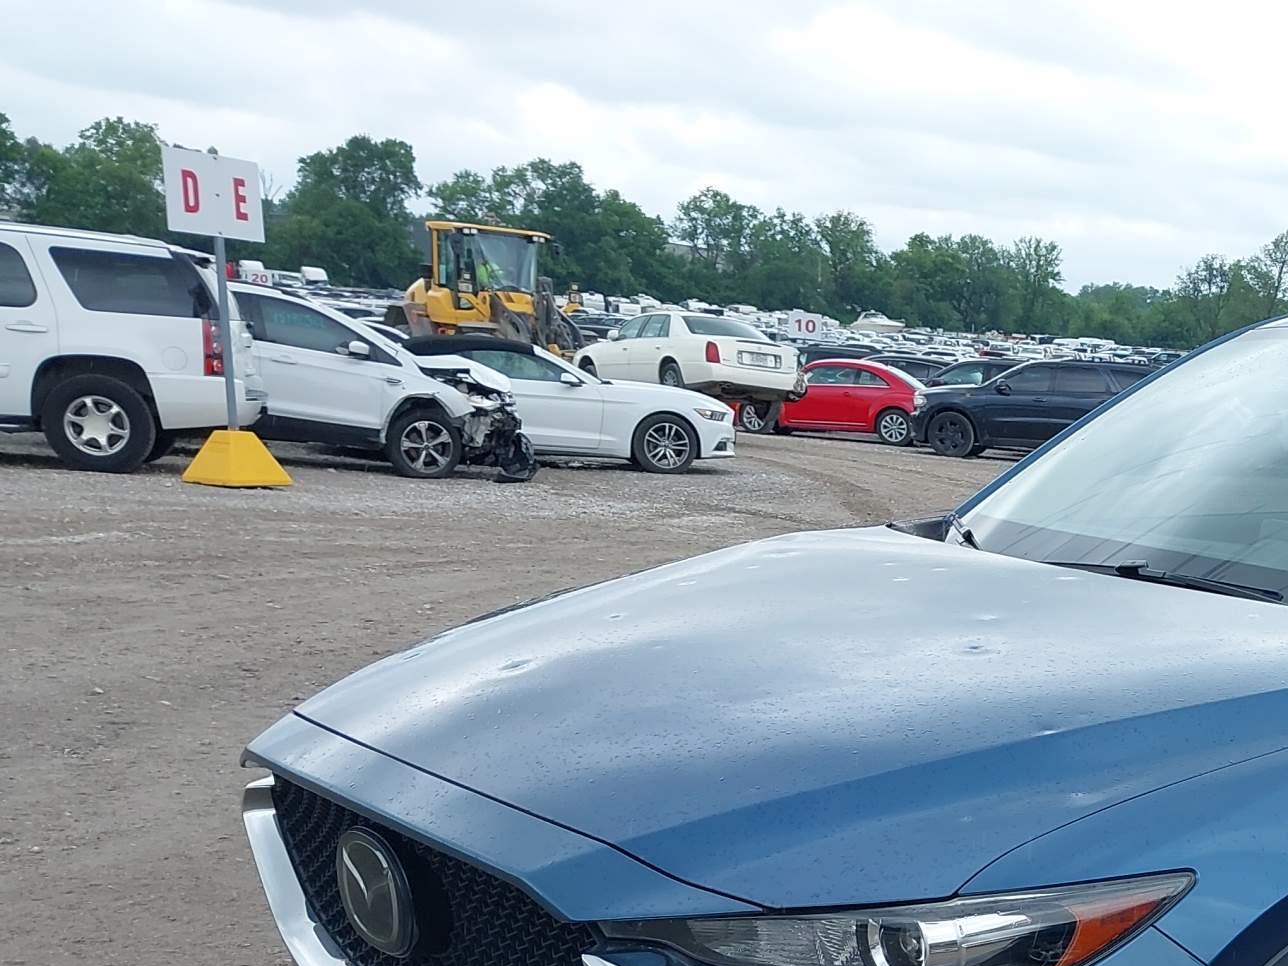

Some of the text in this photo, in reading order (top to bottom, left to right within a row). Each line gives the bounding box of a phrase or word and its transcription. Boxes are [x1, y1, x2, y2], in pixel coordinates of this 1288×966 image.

[181, 169, 249, 222] D E
[251, 273, 269, 284] 20
[794, 318, 816, 334] 10
